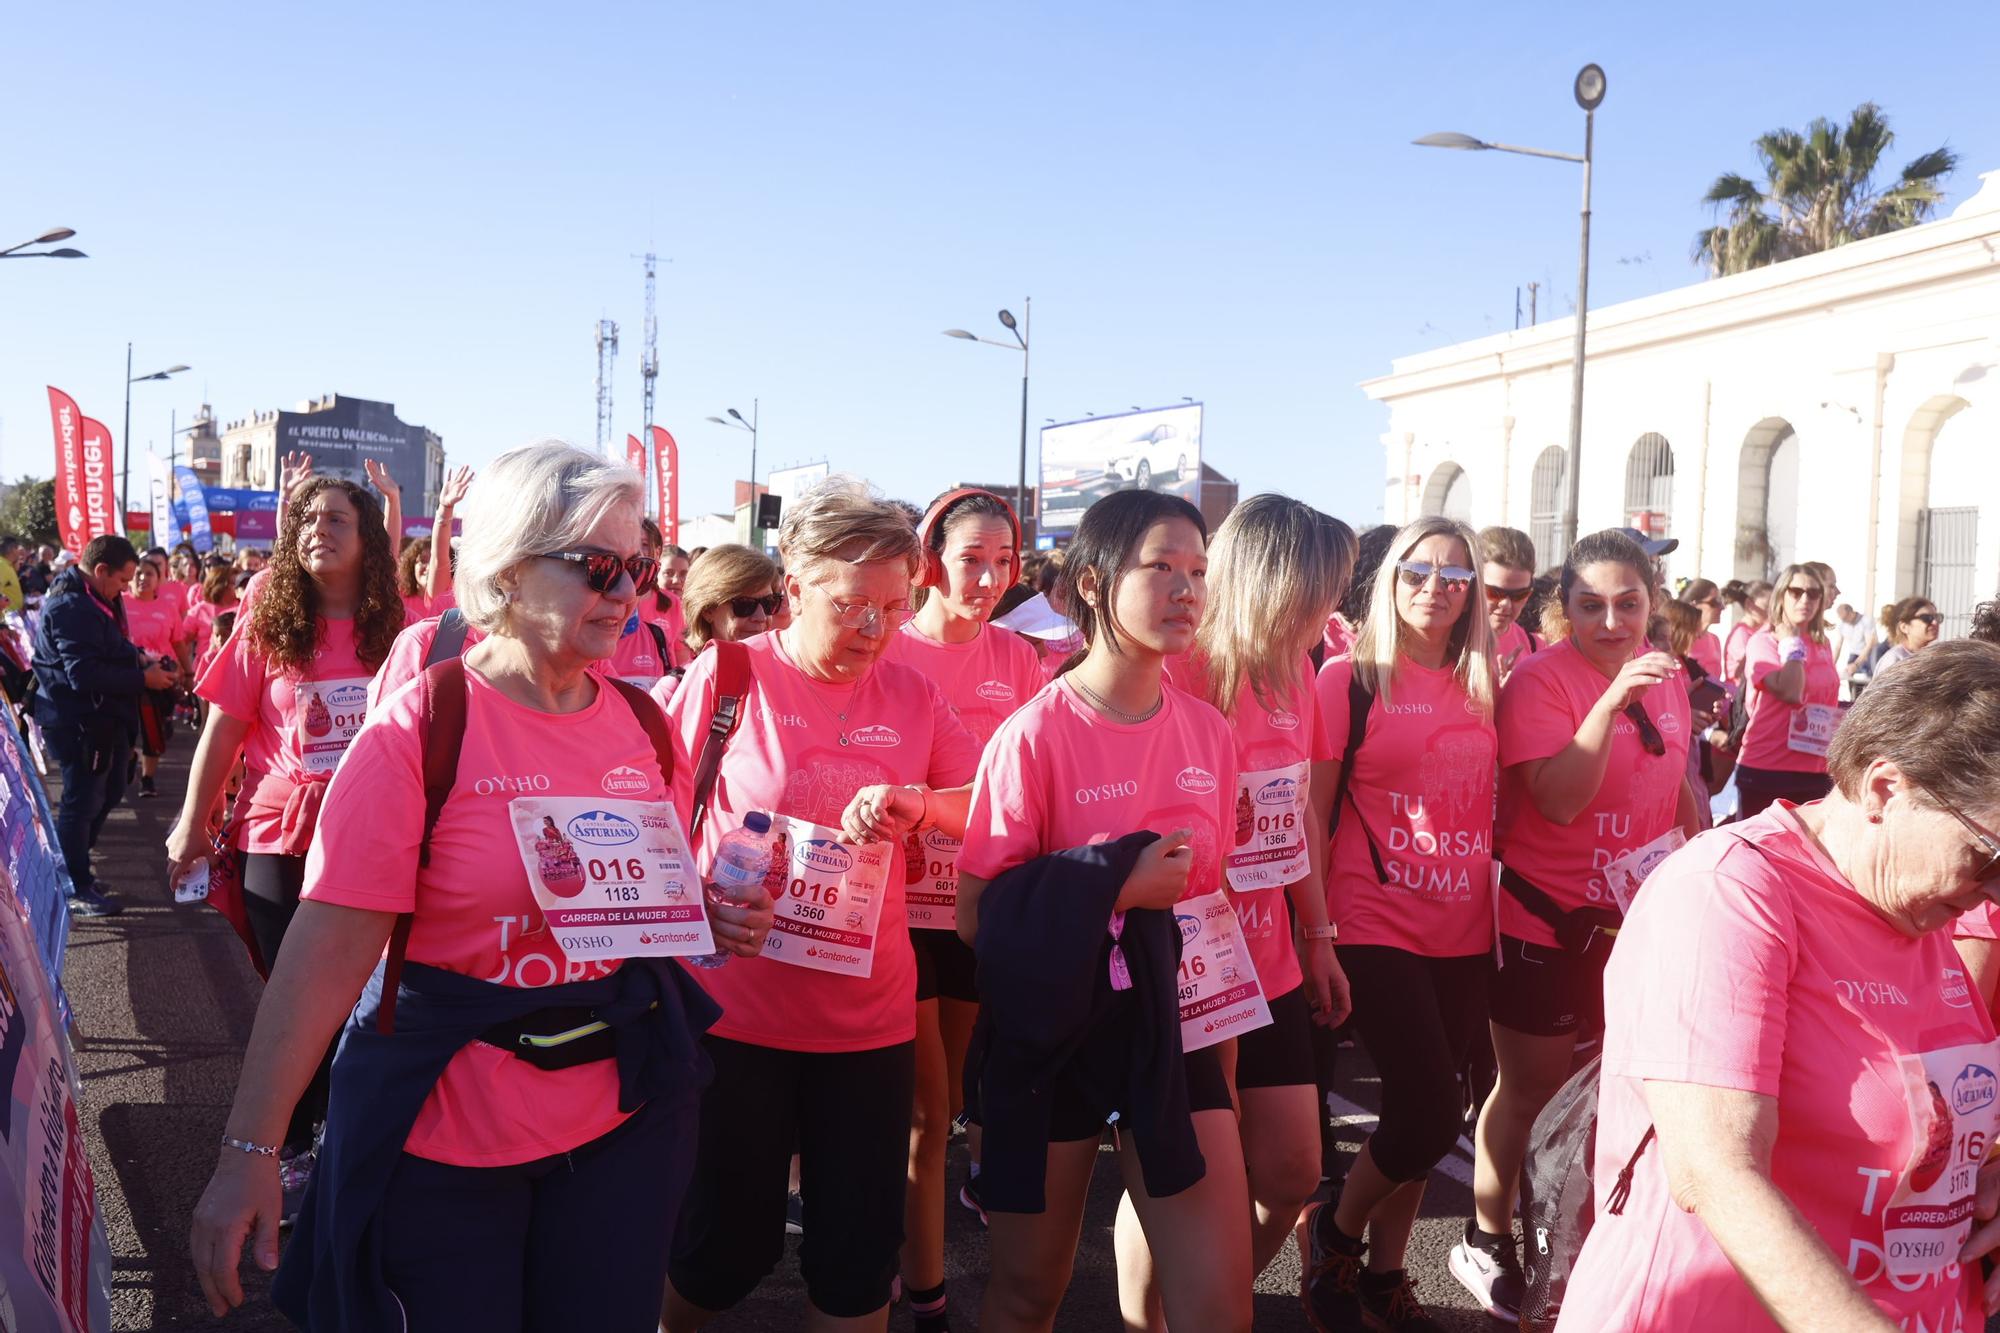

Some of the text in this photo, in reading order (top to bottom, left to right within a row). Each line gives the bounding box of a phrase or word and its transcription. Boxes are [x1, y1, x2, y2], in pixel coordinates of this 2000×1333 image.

[302, 426, 340, 440] PUERTO
[1385, 703, 1433, 714] OYSHO
[335, 712, 366, 727] 016
[343, 728, 359, 738] 500
[854, 734, 897, 743] ASTURIANA
[606, 777, 647, 790] ASTURIANA
[1076, 780, 1138, 804] OYSHO
[1260, 789, 1295, 801] ASTURIAN
[1388, 791, 1423, 819] TU
[641, 820, 670, 829] SUMA
[1257, 812, 1295, 832] 016
[1594, 813, 1630, 838] TU
[575, 823, 635, 838] ASTURIANA
[929, 834, 962, 846] ASTURI
[1264, 833, 1287, 846] 1366
[1388, 826, 1490, 857] DORSAL
[797, 846, 848, 868] ASTURIANA
[858, 856, 880, 866] SUMA
[1234, 855, 1264, 865] CARRERA
[1274, 851, 1282, 859] LA
[588, 858, 645, 881] 016
[929, 861, 955, 877] 01
[1236, 870, 1268, 882] OYSHO
[1387, 860, 1471, 893] SUMA
[605, 887, 640, 901] 1183
[790, 878, 838, 905] 016
[1585, 878, 1617, 903] SU
[906, 895, 932, 903] ARRERA
[934, 896, 943, 904] DE
[560, 910, 690, 923] CARRERA DE LA MUJER 2023
[793, 903, 825, 920] 3560
[907, 910, 932, 920] SHO
[1205, 906, 1230, 920] SUMA
[1237, 899, 1272, 929] MA
[652, 932, 700, 944] Santander
[788, 923, 801, 932] DE
[802, 925, 813, 936] LA
[814, 929, 841, 941] MUJER
[843, 934, 861, 944] 2023
[562, 935, 613, 950] OYSHO
[818, 949, 861, 965] Santander
[1180, 955, 1206, 981] 16
[1178, 983, 1198, 1001] 497
[1191, 1007, 1201, 1015] LA
[1202, 995, 1227, 1012] MUJER
[1228, 988, 1246, 1001] 2023
[1213, 1007, 1257, 1030] Santander
[1958, 1130, 1985, 1162] 16
[1950, 1169, 1969, 1194] 3178
[1889, 1241, 1944, 1259] OYSHO
